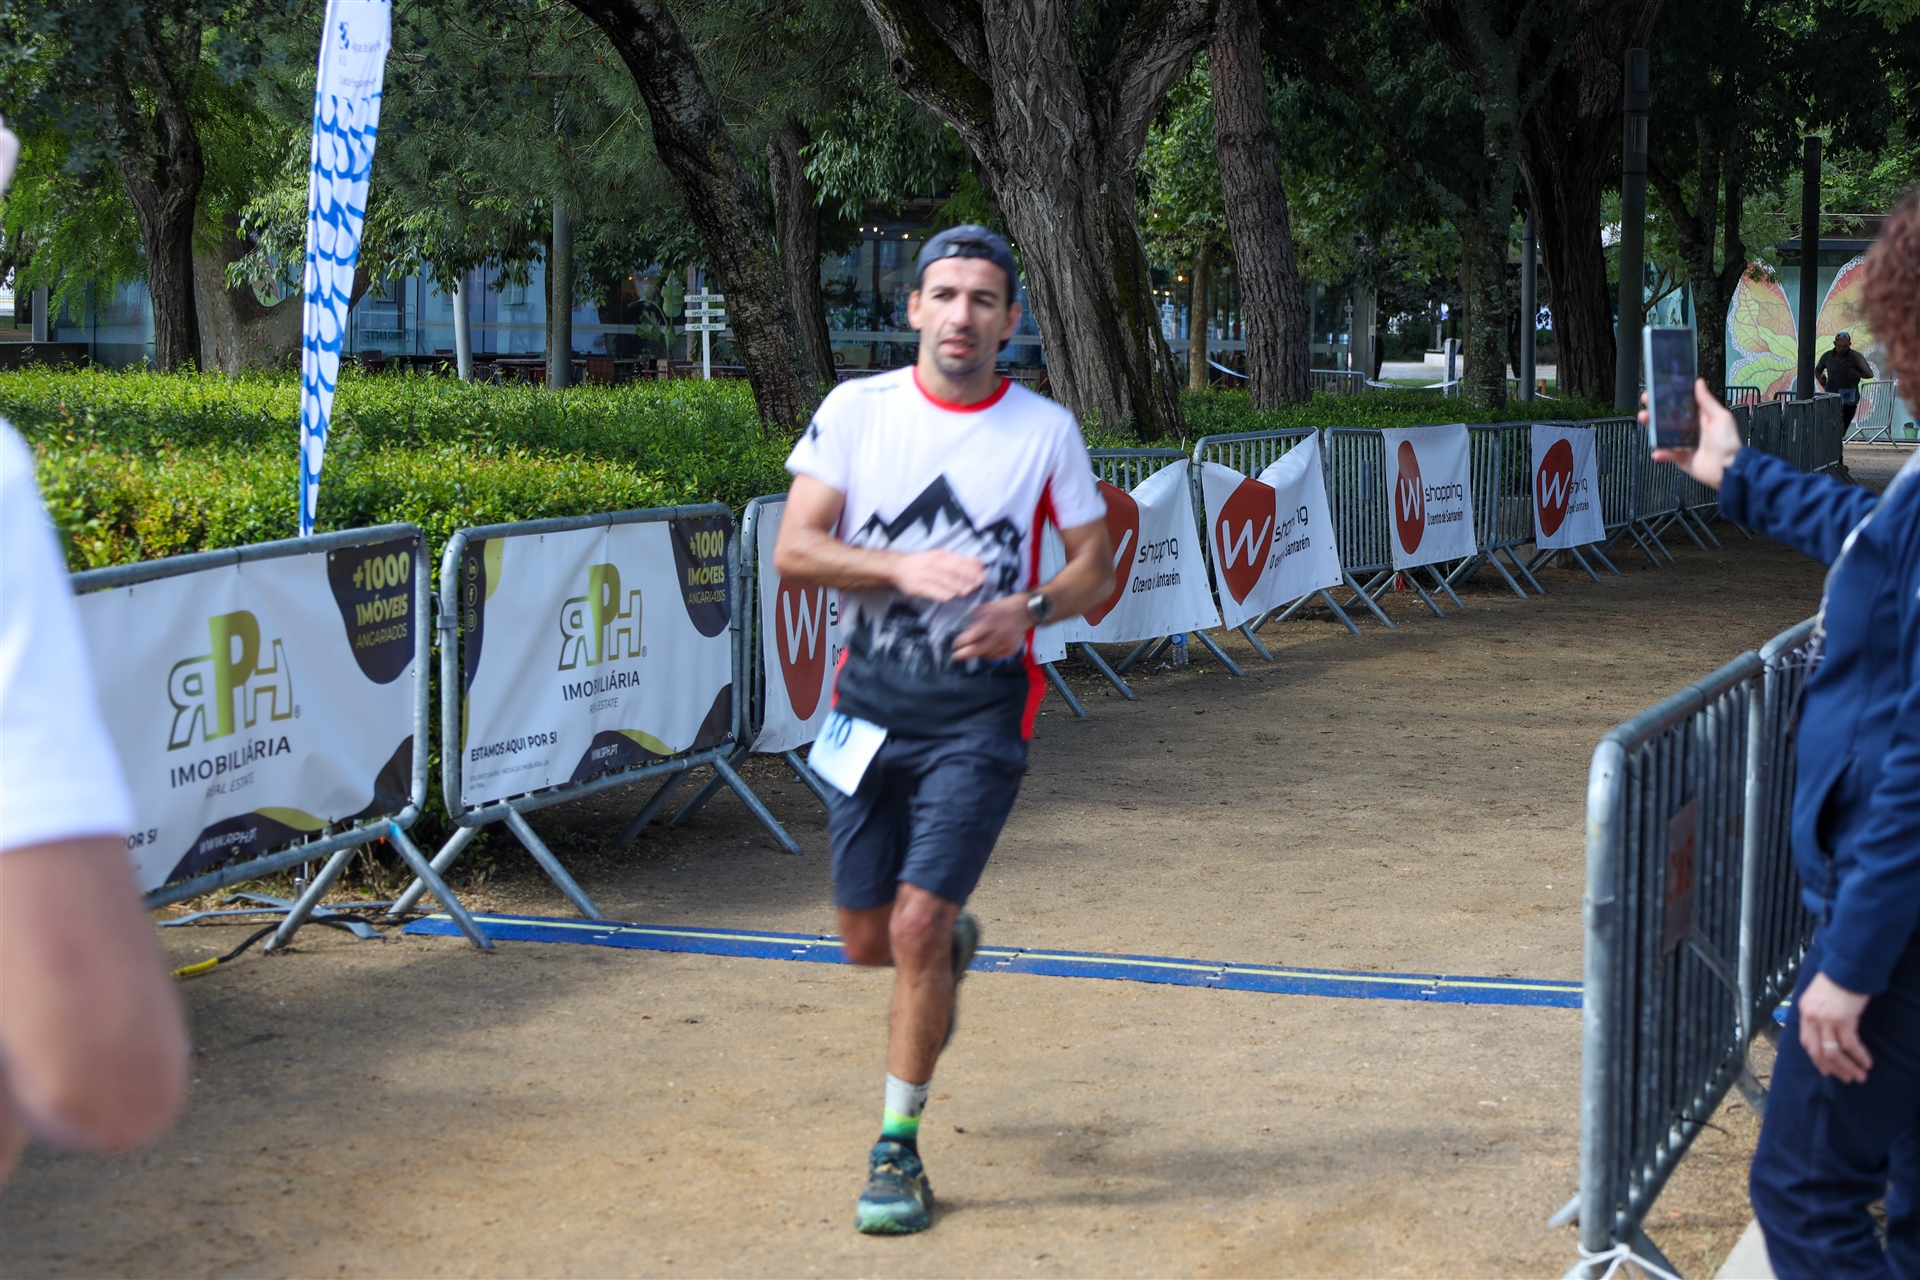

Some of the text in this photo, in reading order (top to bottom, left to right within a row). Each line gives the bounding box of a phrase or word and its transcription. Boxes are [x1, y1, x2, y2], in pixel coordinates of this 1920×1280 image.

[1425, 482, 1463, 504] shopping
[690, 529, 724, 558] +1000
[1222, 515, 1272, 570] W
[352, 551, 410, 591] +1000
[356, 594, 409, 626] IMÓVEIS
[782, 584, 824, 665] W
[355, 622, 408, 649] ANGARIADOS
[562, 670, 640, 701] IMOBILIÁRIA
[170, 735, 291, 788] IMOBILIÁRIA
[471, 731, 558, 762] ESTAMOS AQUI POR SI
